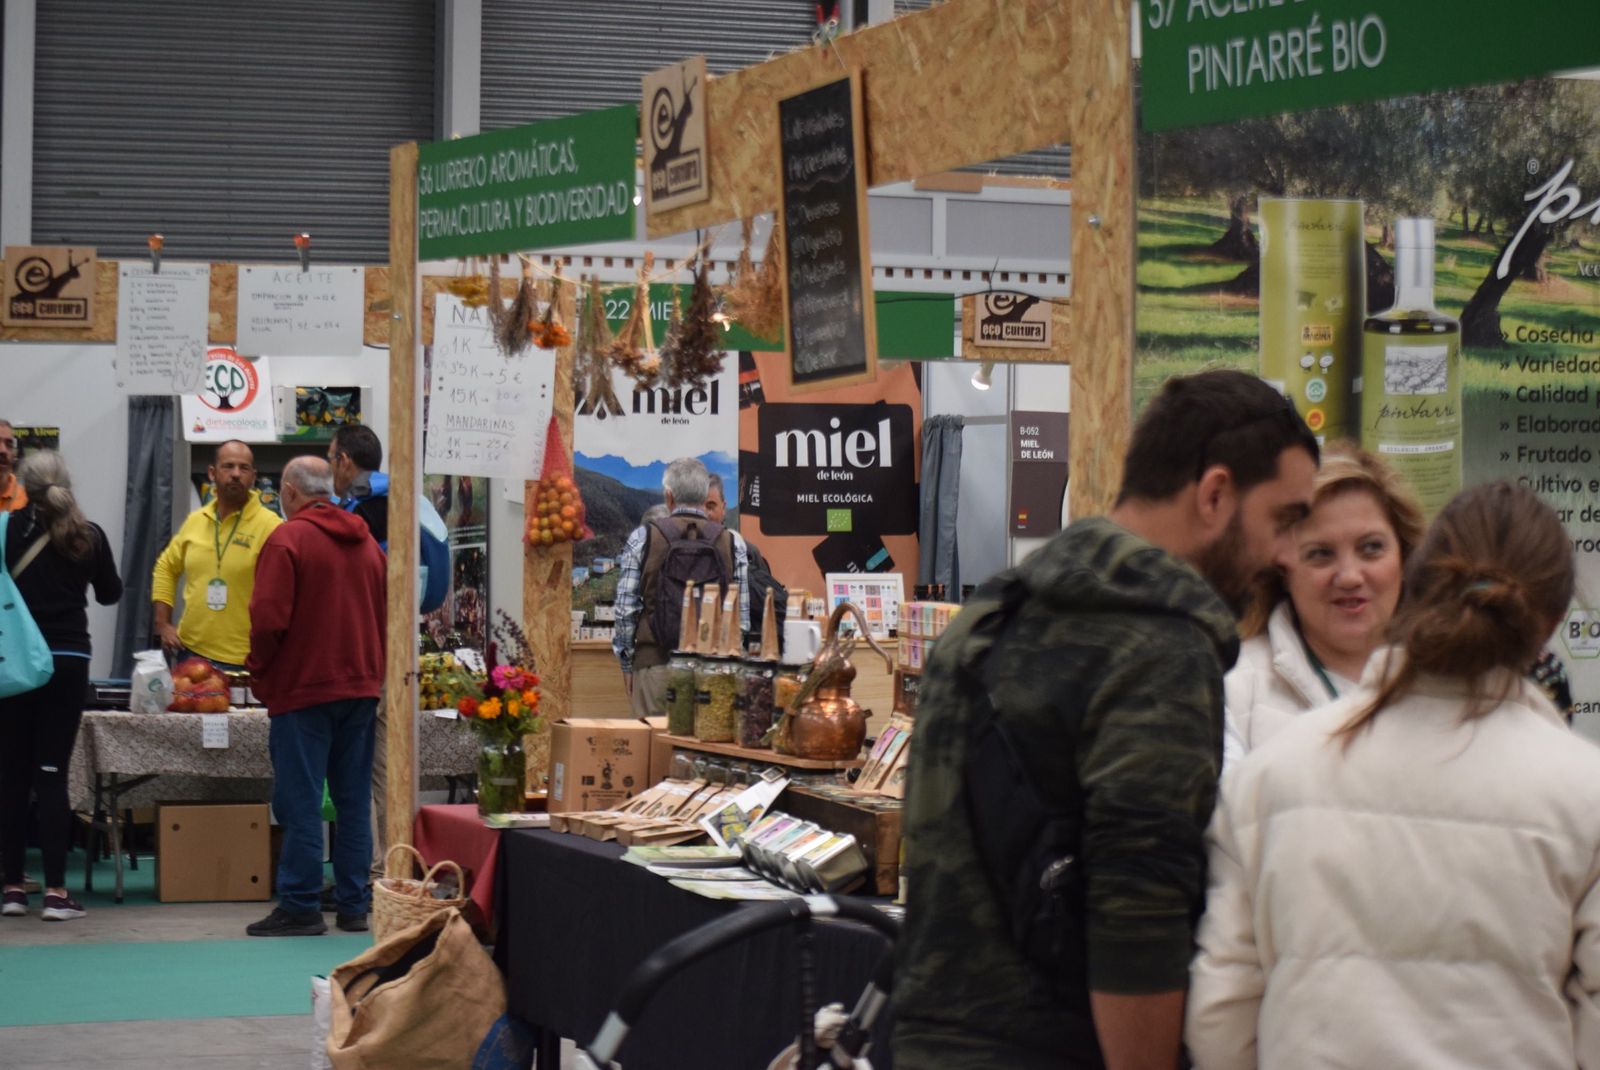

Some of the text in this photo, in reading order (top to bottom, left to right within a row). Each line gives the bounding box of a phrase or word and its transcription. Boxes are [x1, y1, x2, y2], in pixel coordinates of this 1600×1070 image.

[1188, 10, 1387, 94] PINTARRÉ BIO
[420, 138, 579, 195] 56 LURREKO AROMÁTICAS,
[420, 181, 629, 239] PERMACULTURA Y BIODIVERSIDAD
[273, 271, 334, 284] ACEITE
[605, 300, 630, 320] 22
[982, 324, 1041, 337] eco cultura
[1516, 323, 1594, 343] Cosecha
[632, 378, 719, 416] miel
[1516, 384, 1588, 403] Calidad
[446, 414, 516, 431] MANDARINAS
[661, 416, 690, 425] de león
[1020, 426, 1040, 436] B-052
[775, 417, 893, 468] miel
[1020, 440, 1040, 449] MIEL
[1021, 449, 1054, 459] DE LEÓN
[1517, 444, 1592, 463] Frutado
[816, 469, 854, 481] de león
[797, 493, 873, 503] MIEL ECOLÓGICA
